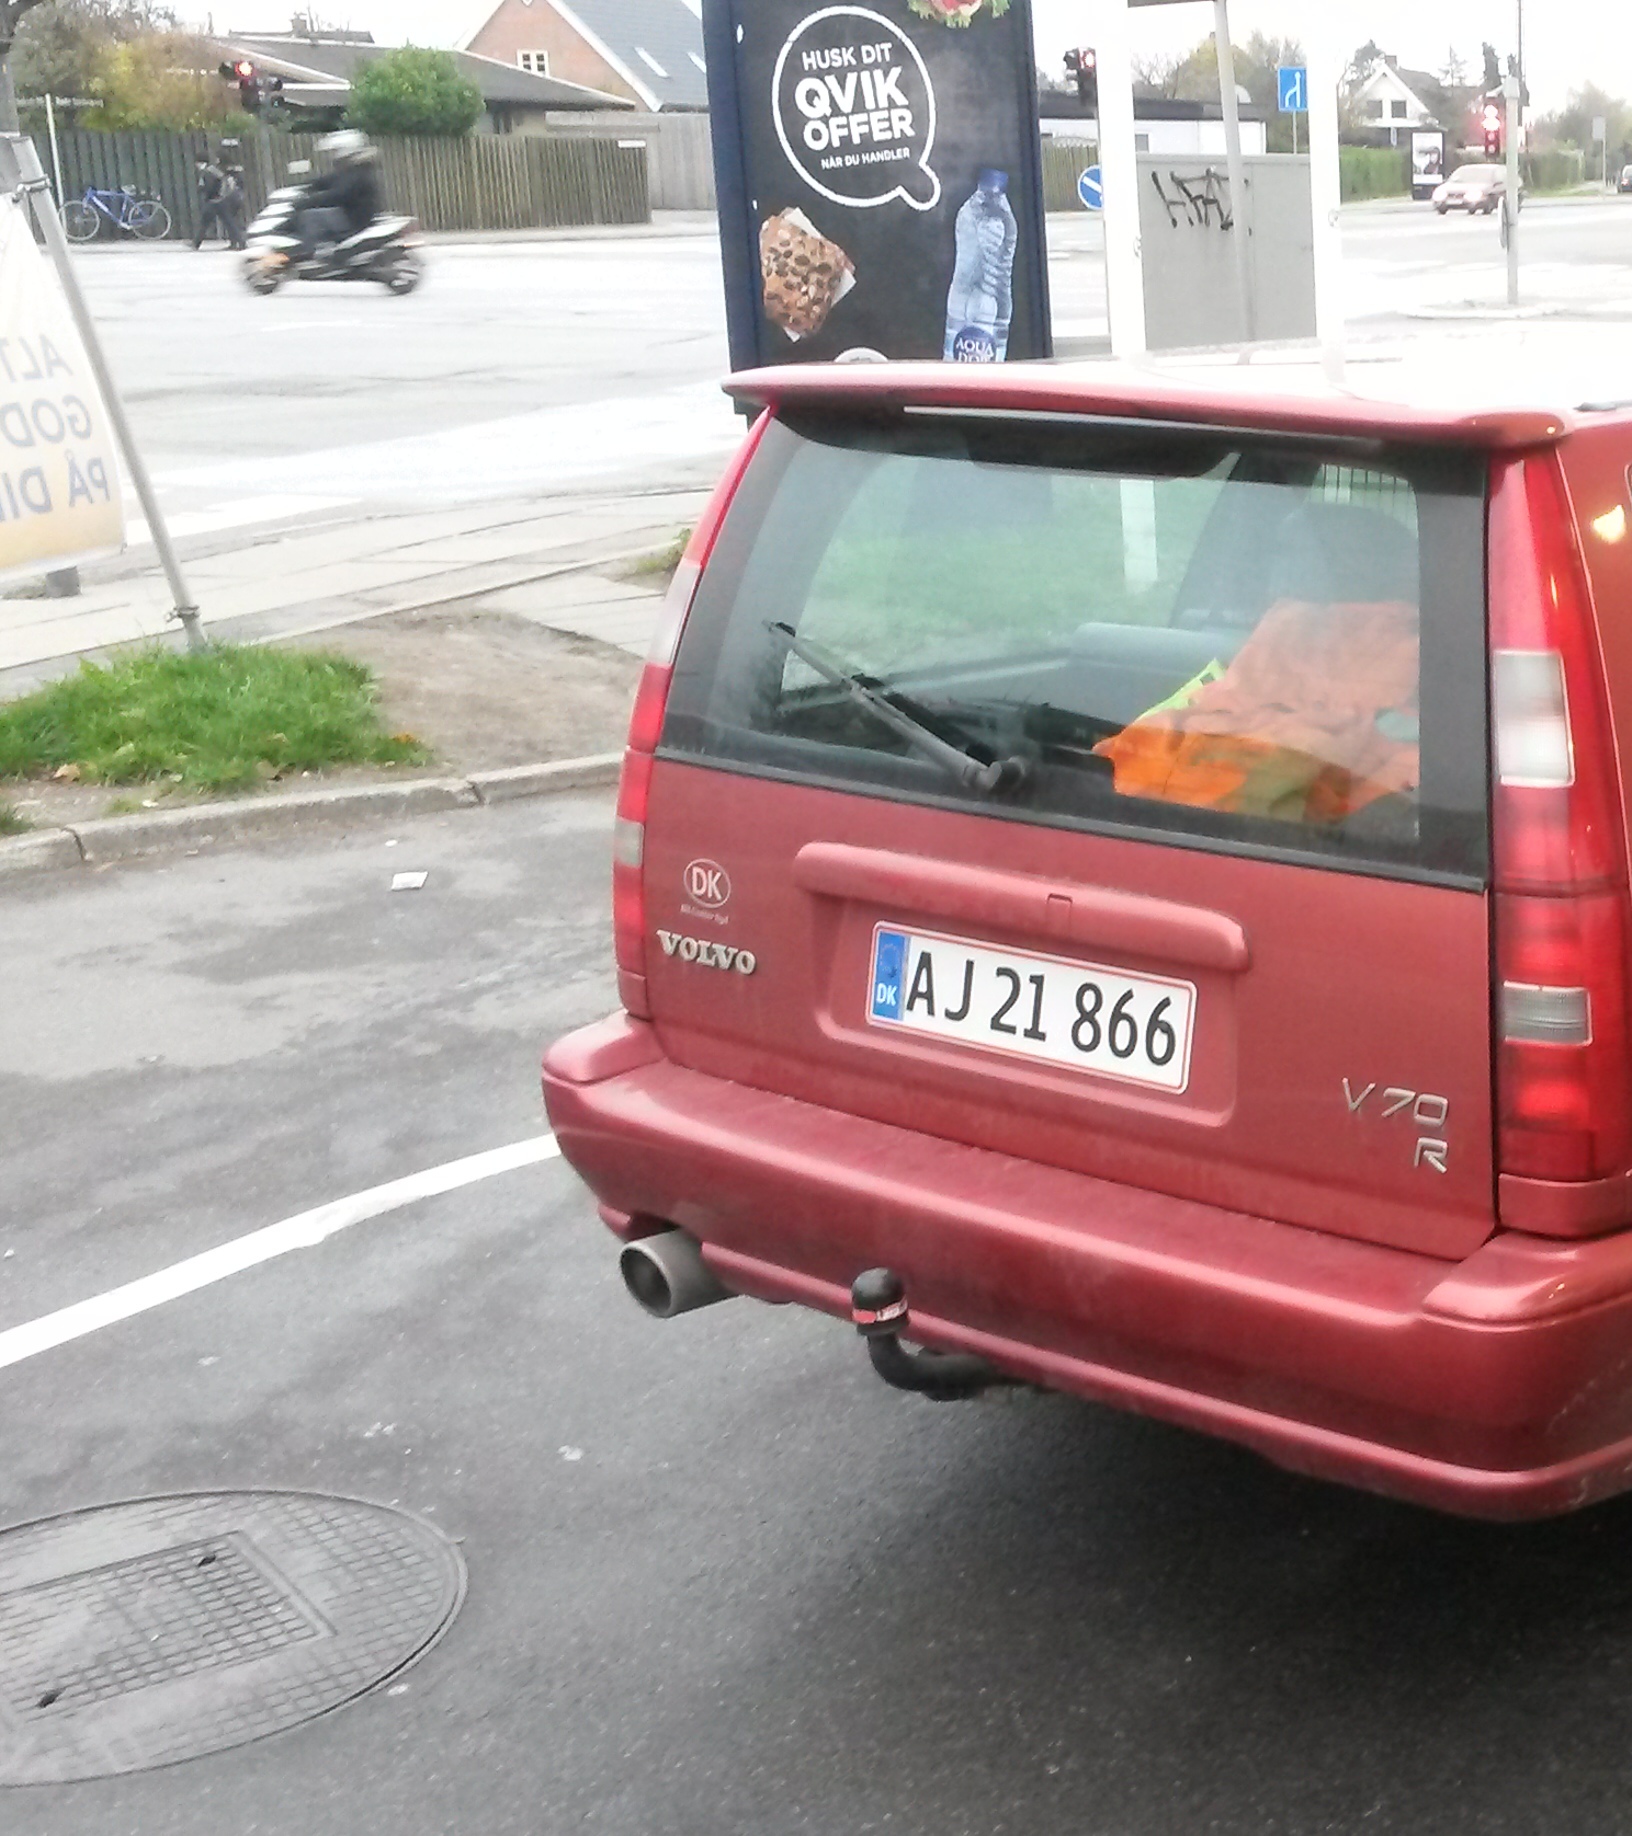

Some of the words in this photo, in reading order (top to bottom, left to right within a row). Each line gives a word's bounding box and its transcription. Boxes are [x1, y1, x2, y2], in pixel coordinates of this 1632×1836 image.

[802, 46, 857, 71] HUSK
[861, 42, 892, 64] DIT
[795, 66, 909, 119] QVIK
[803, 108, 916, 151] OFFER
[845, 153, 860, 167] DU
[861, 147, 911, 164] HANDLER
[956, 337, 995, 358] AQUA
[692, 866, 722, 900] DK
[656, 929, 757, 975] VOLVO
[876, 982, 898, 1007] DK
[906, 951, 975, 1022] AJ
[990, 967, 1047, 1041] 21
[1071, 982, 1176, 1067] 866
[1414, 1137, 1448, 1174] R
